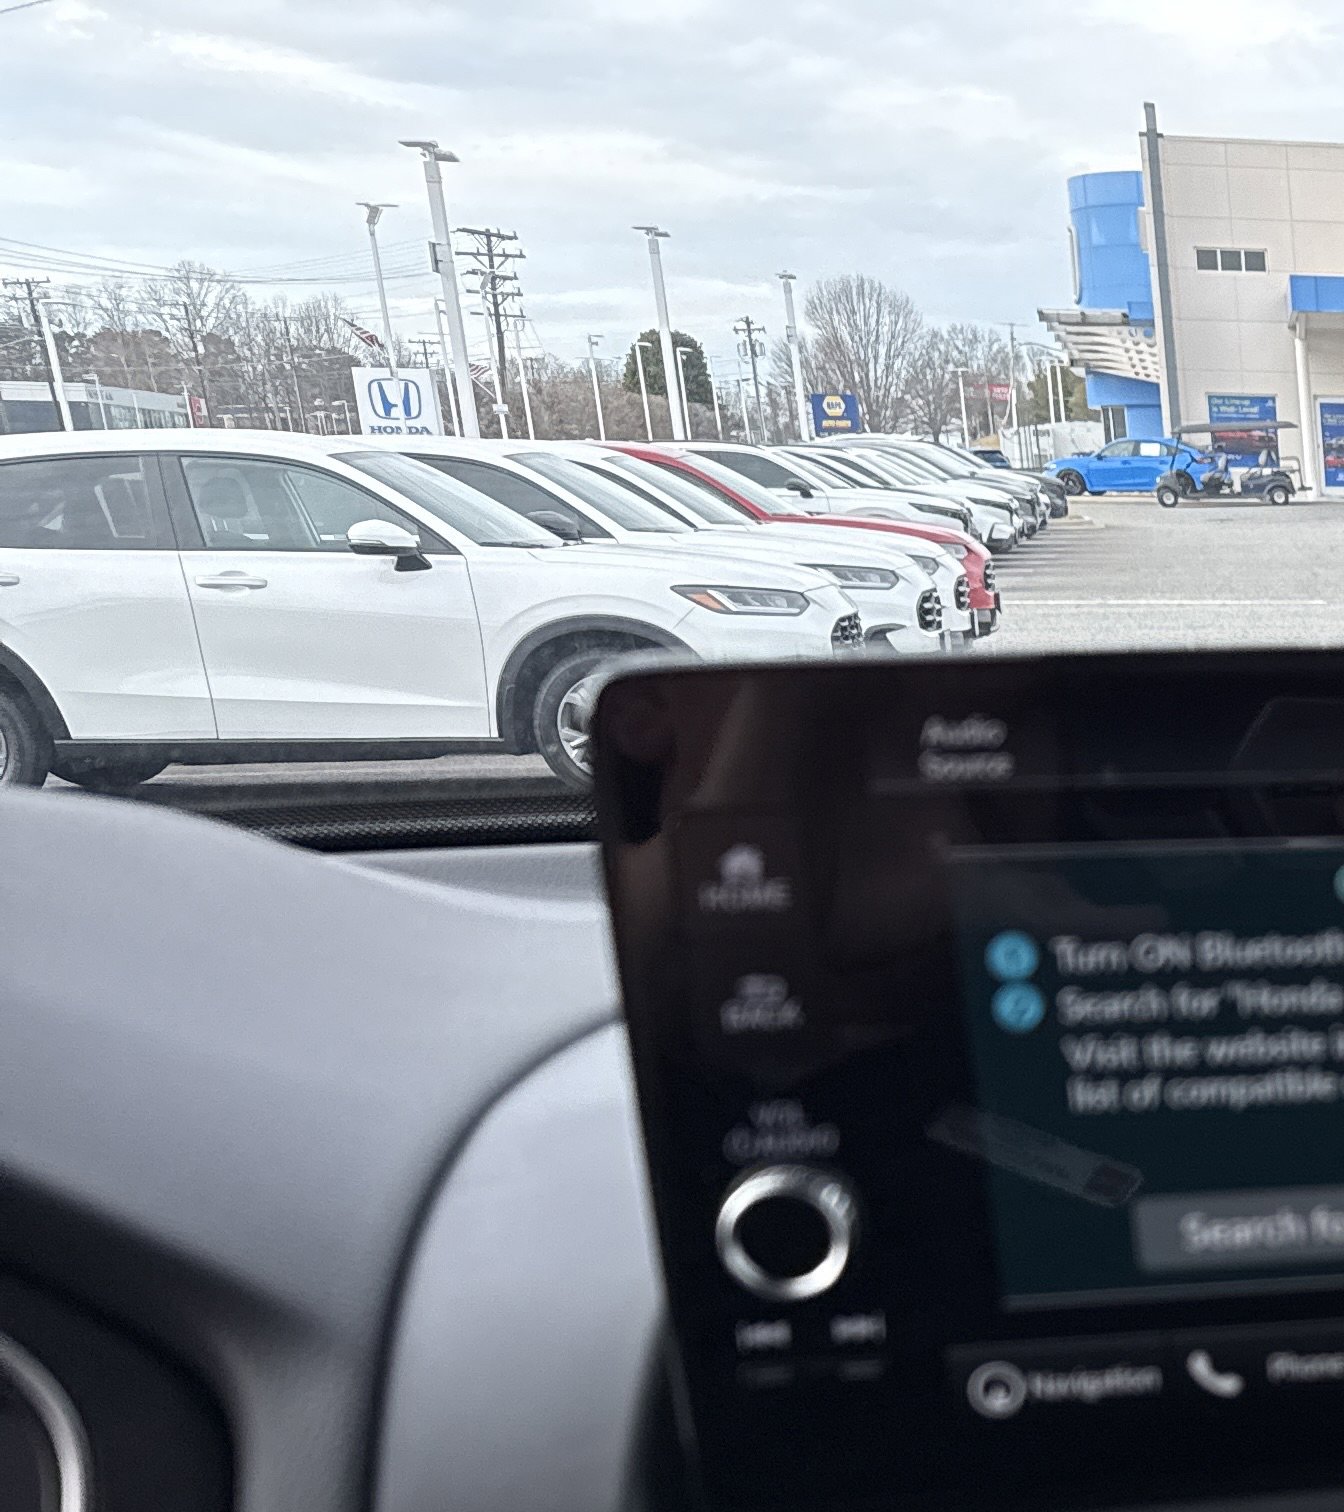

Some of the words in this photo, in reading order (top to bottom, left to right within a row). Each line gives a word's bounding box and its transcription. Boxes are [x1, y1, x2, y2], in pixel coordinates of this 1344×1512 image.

[369, 425, 433, 435] HONDA
[921, 714, 1008, 748] Audio
[918, 750, 1014, 782] Source
[1050, 935, 1129, 975] Turn
[1129, 933, 1195, 973] ON
[1056, 982, 1168, 1027] Search
[1169, 981, 1220, 1021] for
[1060, 1032, 1140, 1072] Visit
[1141, 1028, 1200, 1070] the
[1202, 1026, 1327, 1066] website
[1066, 1073, 1121, 1114] list
[1121, 1073, 1162, 1113] of
[1163, 1066, 1338, 1112] compatible
[1180, 1208, 1307, 1254] Search
[1027, 1364, 1164, 1403] Navigation
